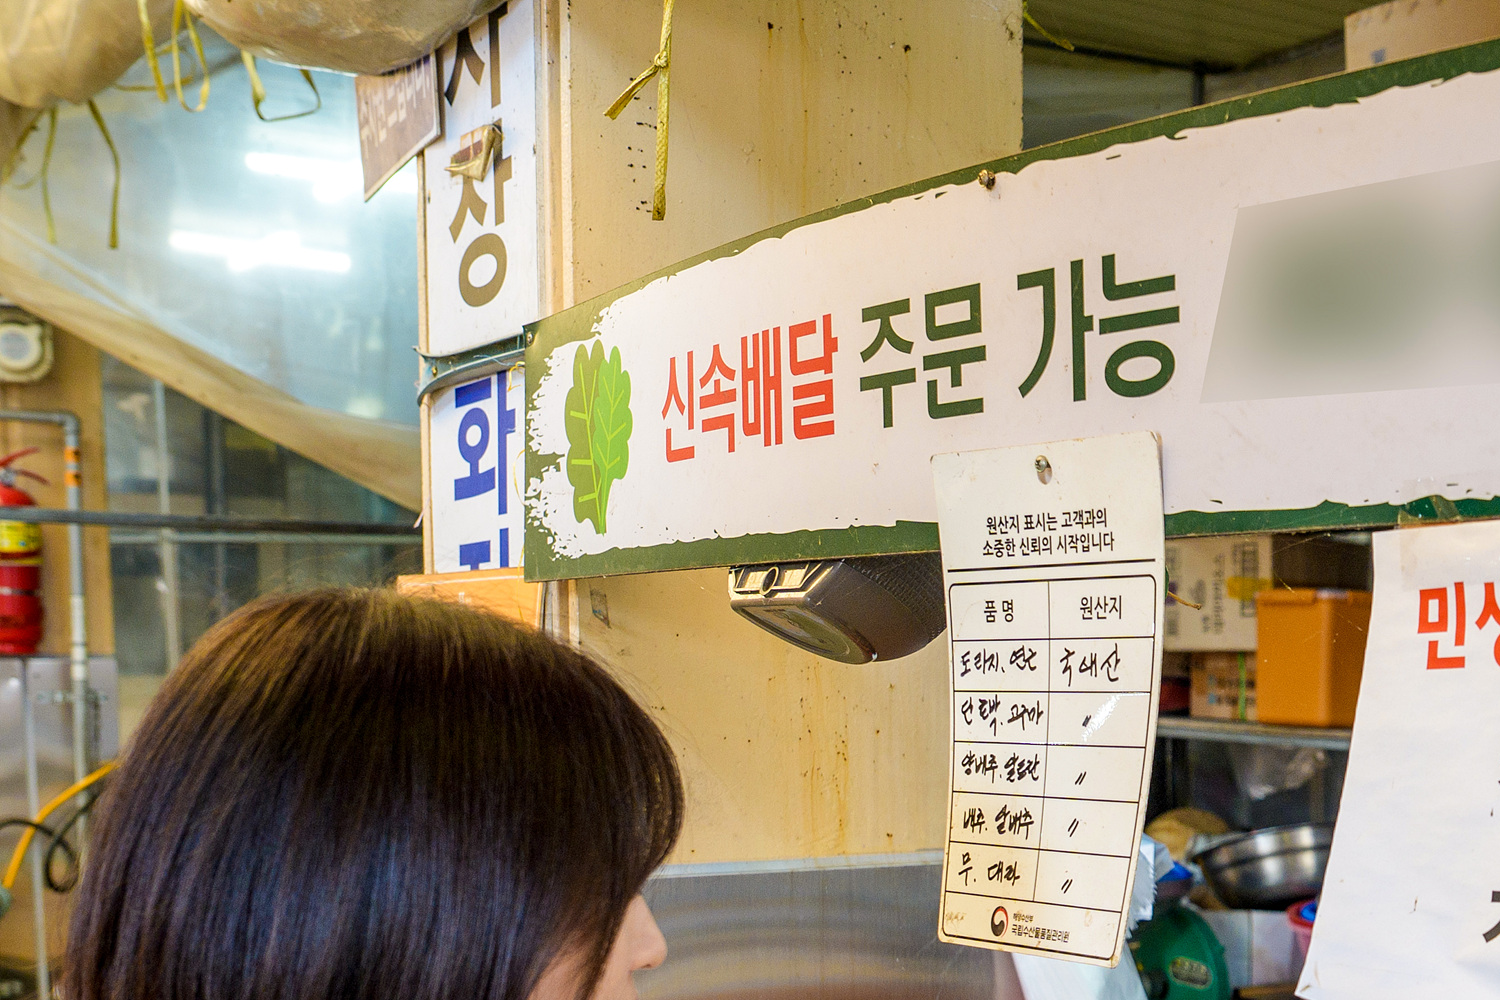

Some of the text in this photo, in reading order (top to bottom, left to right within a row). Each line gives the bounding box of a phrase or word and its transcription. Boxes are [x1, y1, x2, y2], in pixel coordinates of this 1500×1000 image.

[661, 313, 838, 463] 신속배달
[860, 283, 987, 428] 주문
[1017, 253, 1180, 402] 가능
[986, 507, 1108, 535] 원산지 표시는 고객과의
[982, 531, 1115, 558] 소중한 신뢰의 시작입니다
[1079, 595, 1122, 620] 원산지
